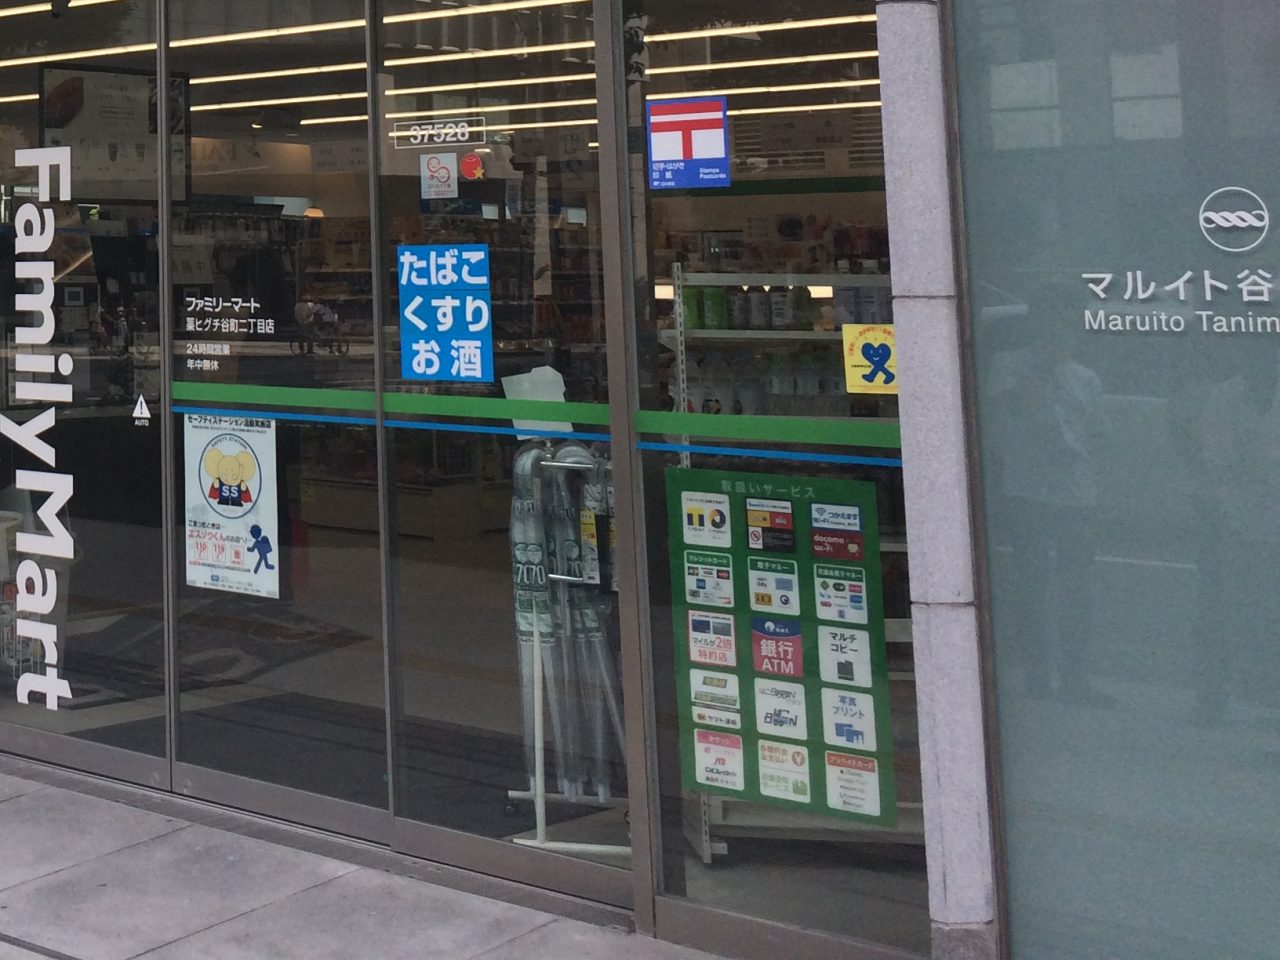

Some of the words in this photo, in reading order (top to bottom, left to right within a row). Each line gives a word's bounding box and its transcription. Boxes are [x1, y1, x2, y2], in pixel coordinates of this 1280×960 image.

[410, 122, 470, 144] 37528
[400, 249, 488, 286] たばこ
[1081, 269, 1273, 302] マルイト谷
[186, 297, 261, 314] ファミリーマート
[403, 296, 489, 332] くすり
[1084, 310, 1185, 332] Maruito
[1195, 310, 1280, 332] Tanim
[186, 318, 275, 334] 薬ヒグチ谷町二丁目店
[186, 343, 230, 355] 24時間営業
[186, 359, 219, 371] 年中無休
[411, 339, 483, 378] お酒
[0, 146, 74, 711] FamilyMart
[222, 485, 239, 498] SS
[721, 480, 816, 498] 取扱いサービス
[814, 533, 844, 544] docomo
[829, 632, 857, 643] マルチ
[760, 639, 794, 659] 銀行
[830, 643, 858, 654] コピー
[762, 658, 794, 674] ATM
[838, 695, 857, 707] 写真
[832, 706, 865, 719] プリント
